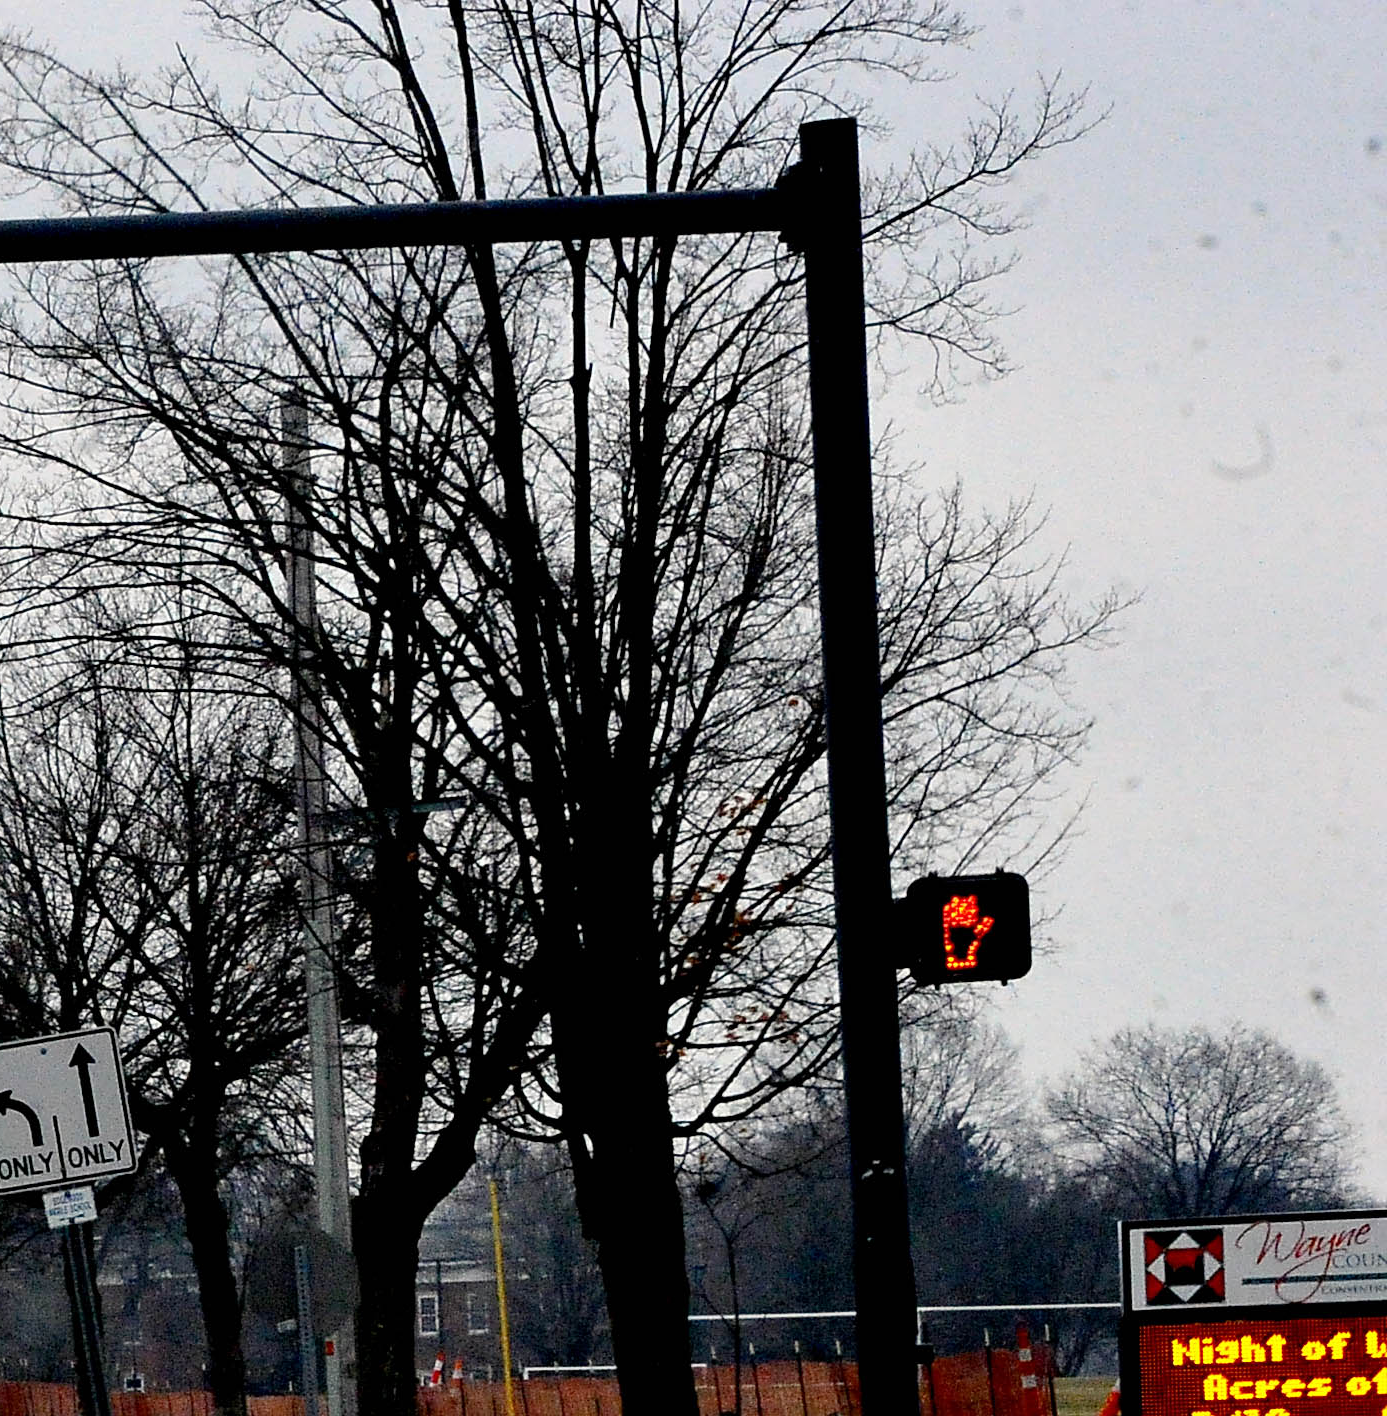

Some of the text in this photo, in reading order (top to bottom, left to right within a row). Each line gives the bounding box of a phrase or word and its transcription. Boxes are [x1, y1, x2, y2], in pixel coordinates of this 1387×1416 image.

[67, 1138, 125, 1168] ONLY
[1235, 1220, 1371, 1304] Wayne
[1172, 1334, 1287, 1366] Night
[1301, 1331, 1351, 1360] of
[1203, 1374, 1332, 1400] Acres
